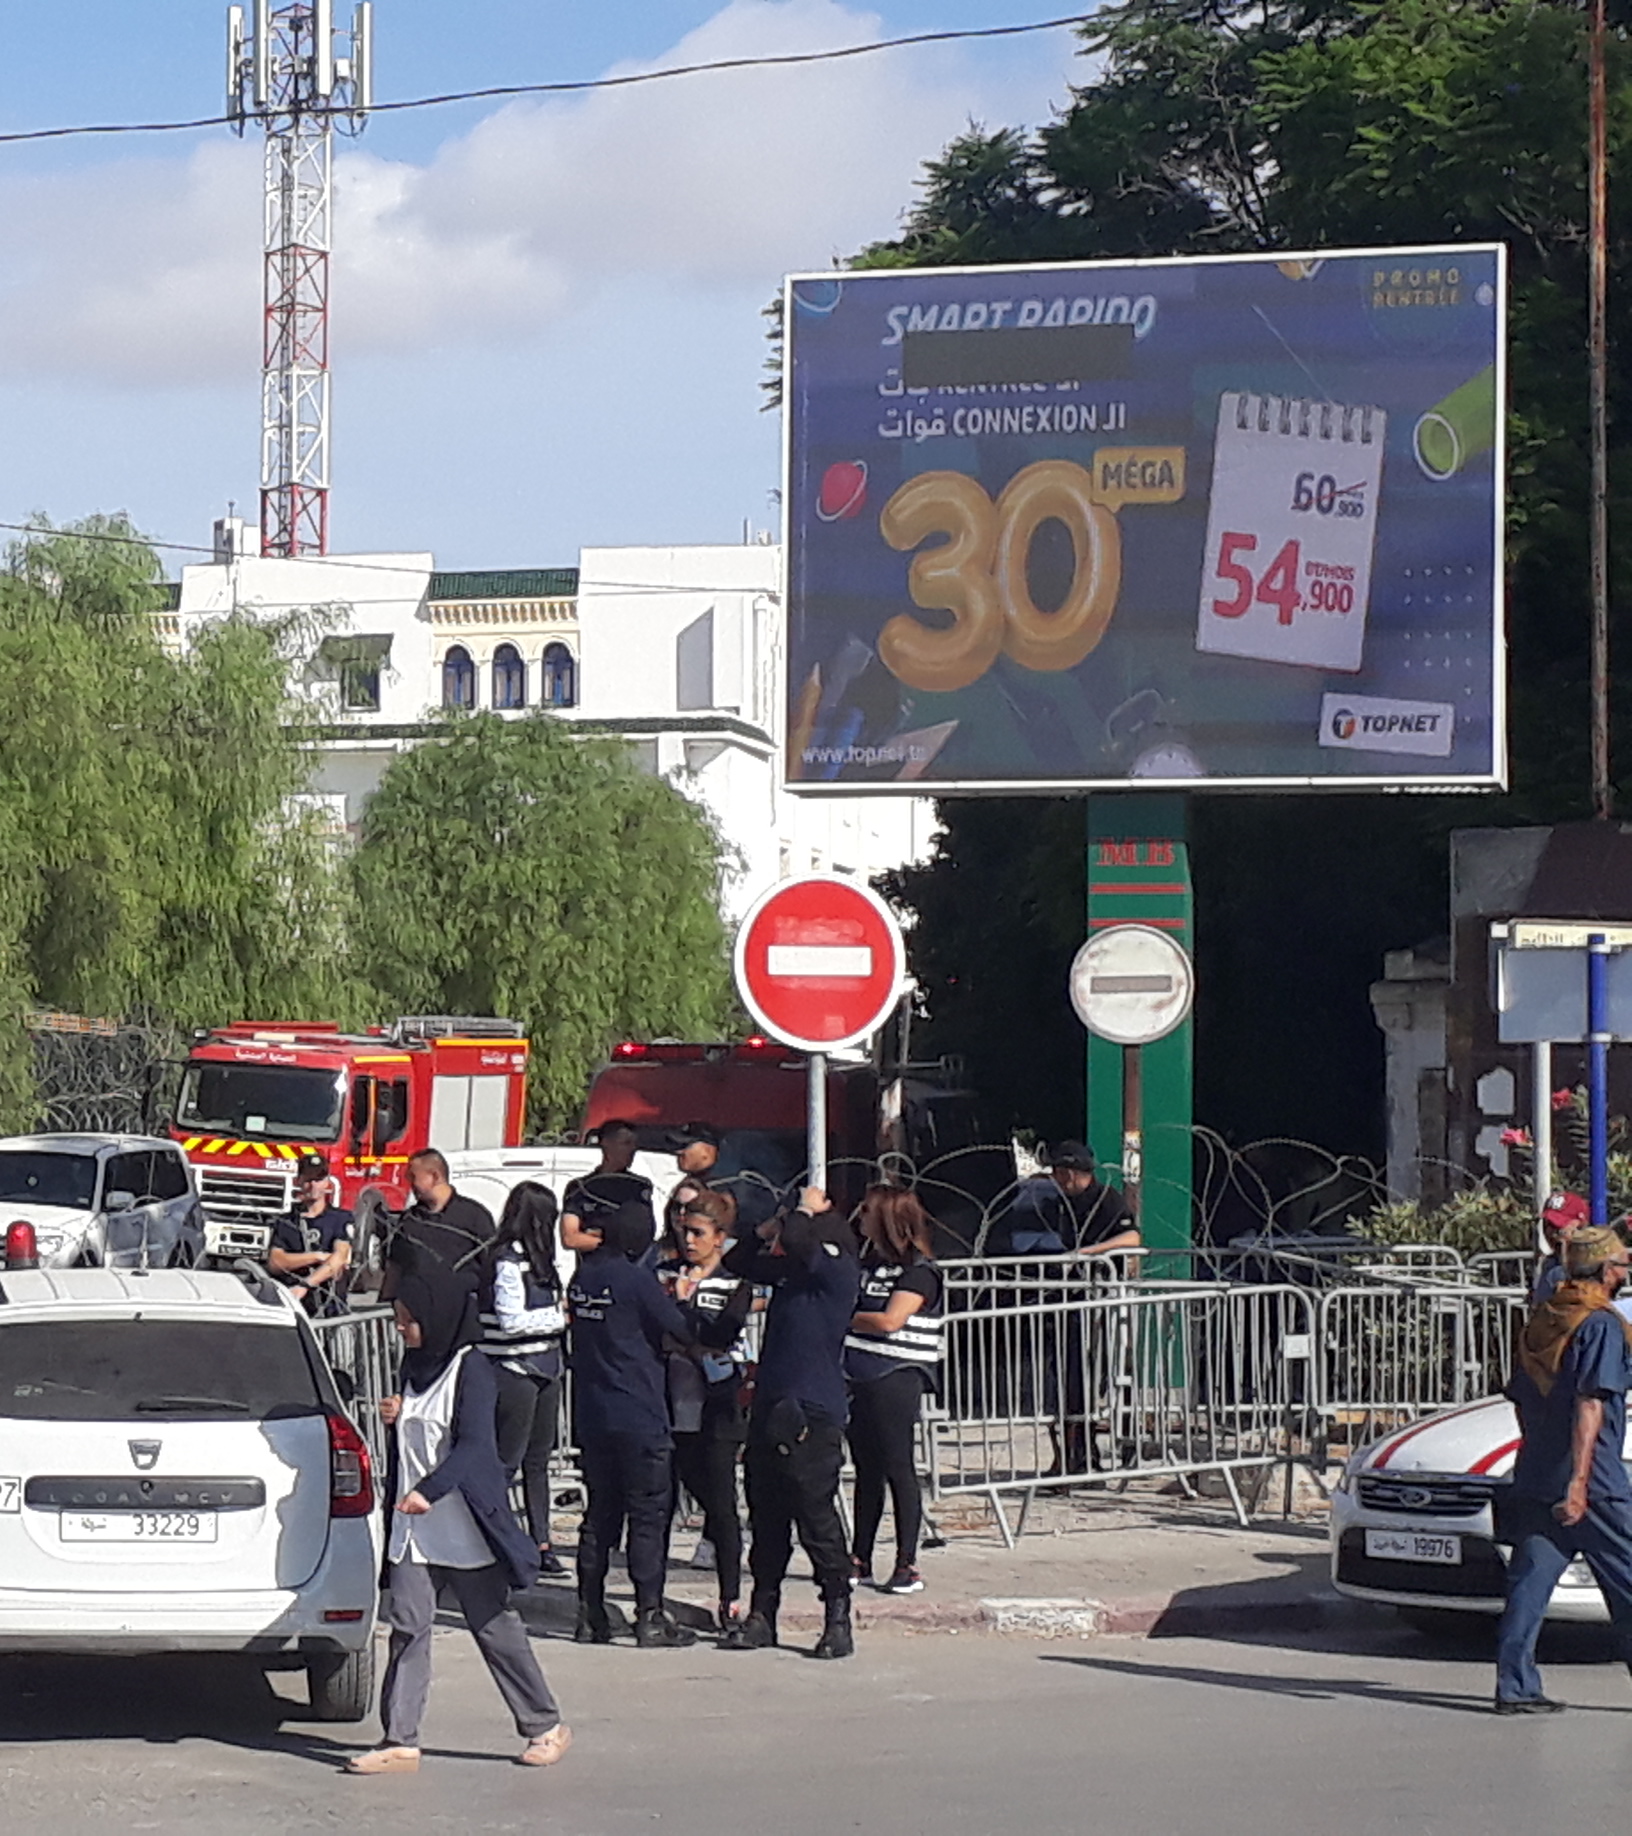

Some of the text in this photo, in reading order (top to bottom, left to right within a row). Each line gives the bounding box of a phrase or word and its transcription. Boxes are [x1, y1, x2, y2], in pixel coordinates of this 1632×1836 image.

[953, 404, 1097, 436] CONNEXION
[1101, 455, 1175, 491] MÉGA
[879, 460, 1123, 692] 30
[1361, 714, 1441, 734] TOPNET
[132, 1513, 200, 1537] 33229
